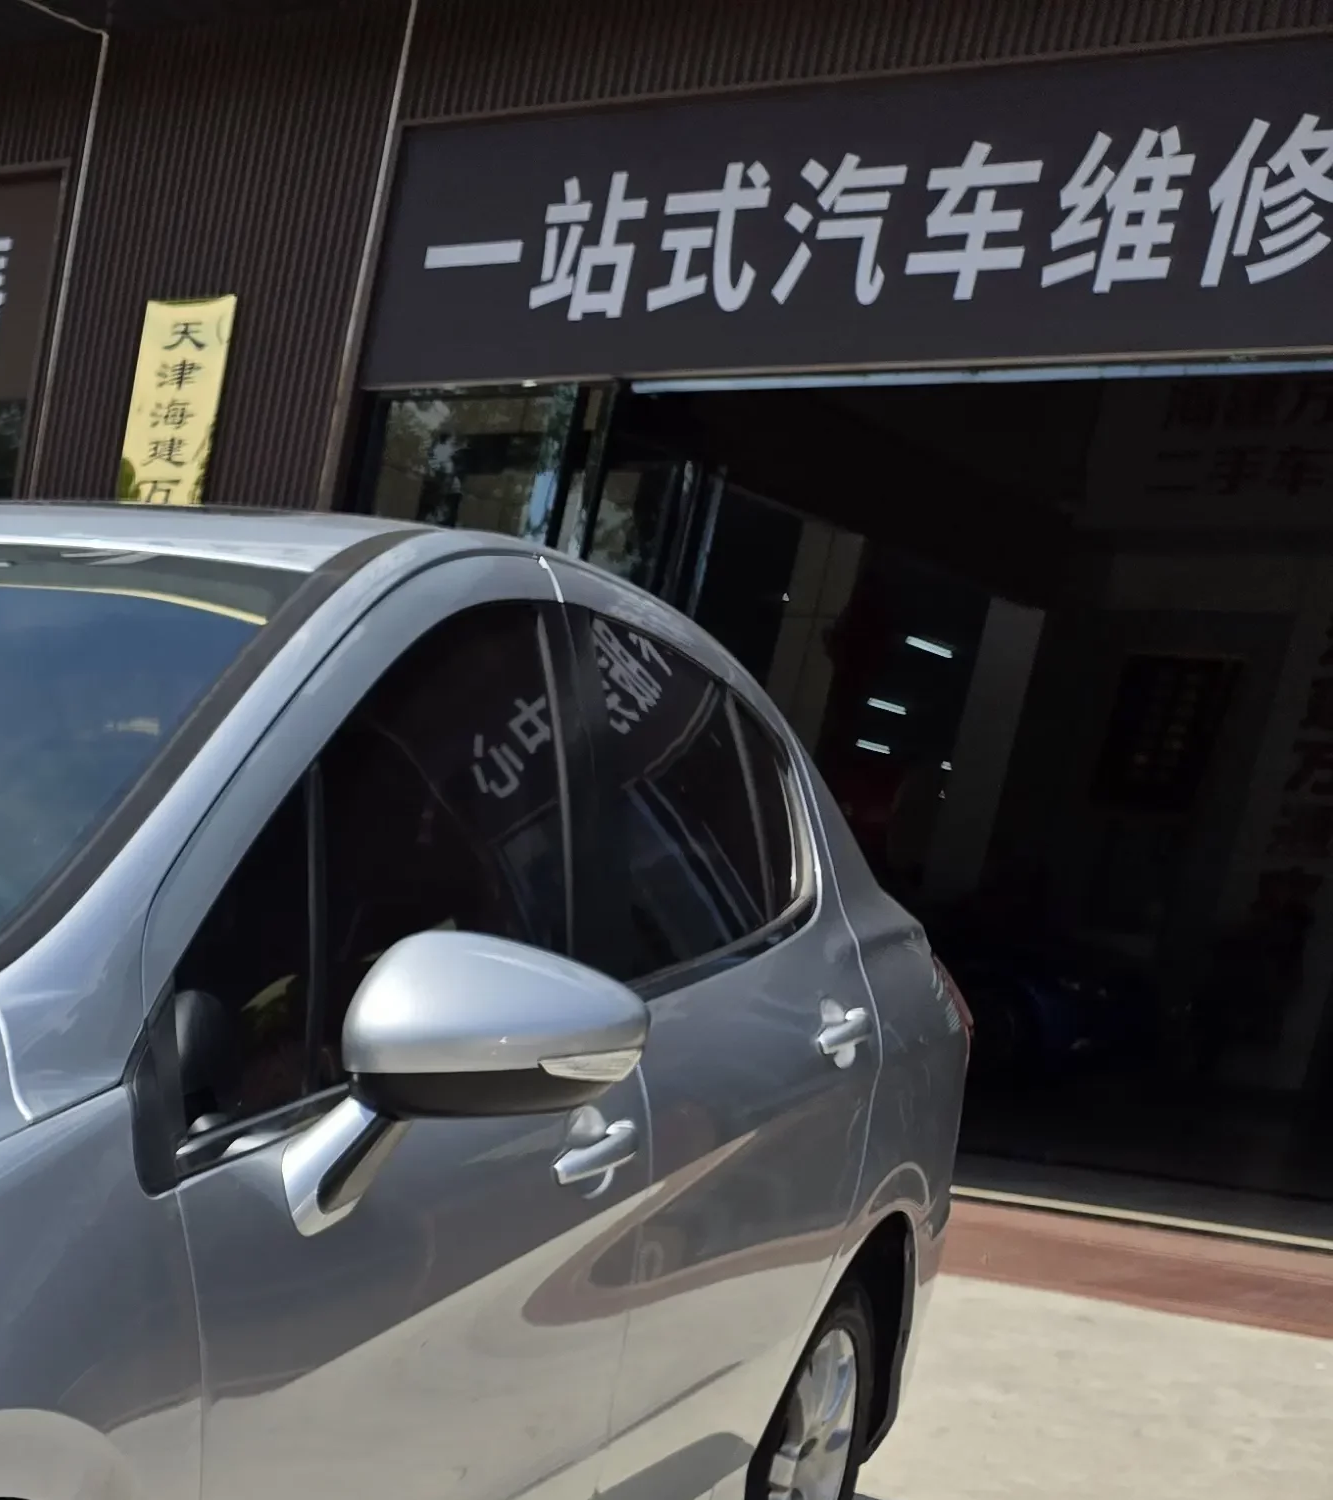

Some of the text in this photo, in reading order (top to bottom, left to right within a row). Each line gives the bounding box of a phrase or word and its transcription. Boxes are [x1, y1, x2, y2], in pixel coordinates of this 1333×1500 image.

[424, 113, 1333, 321] 一站式汽车维修
